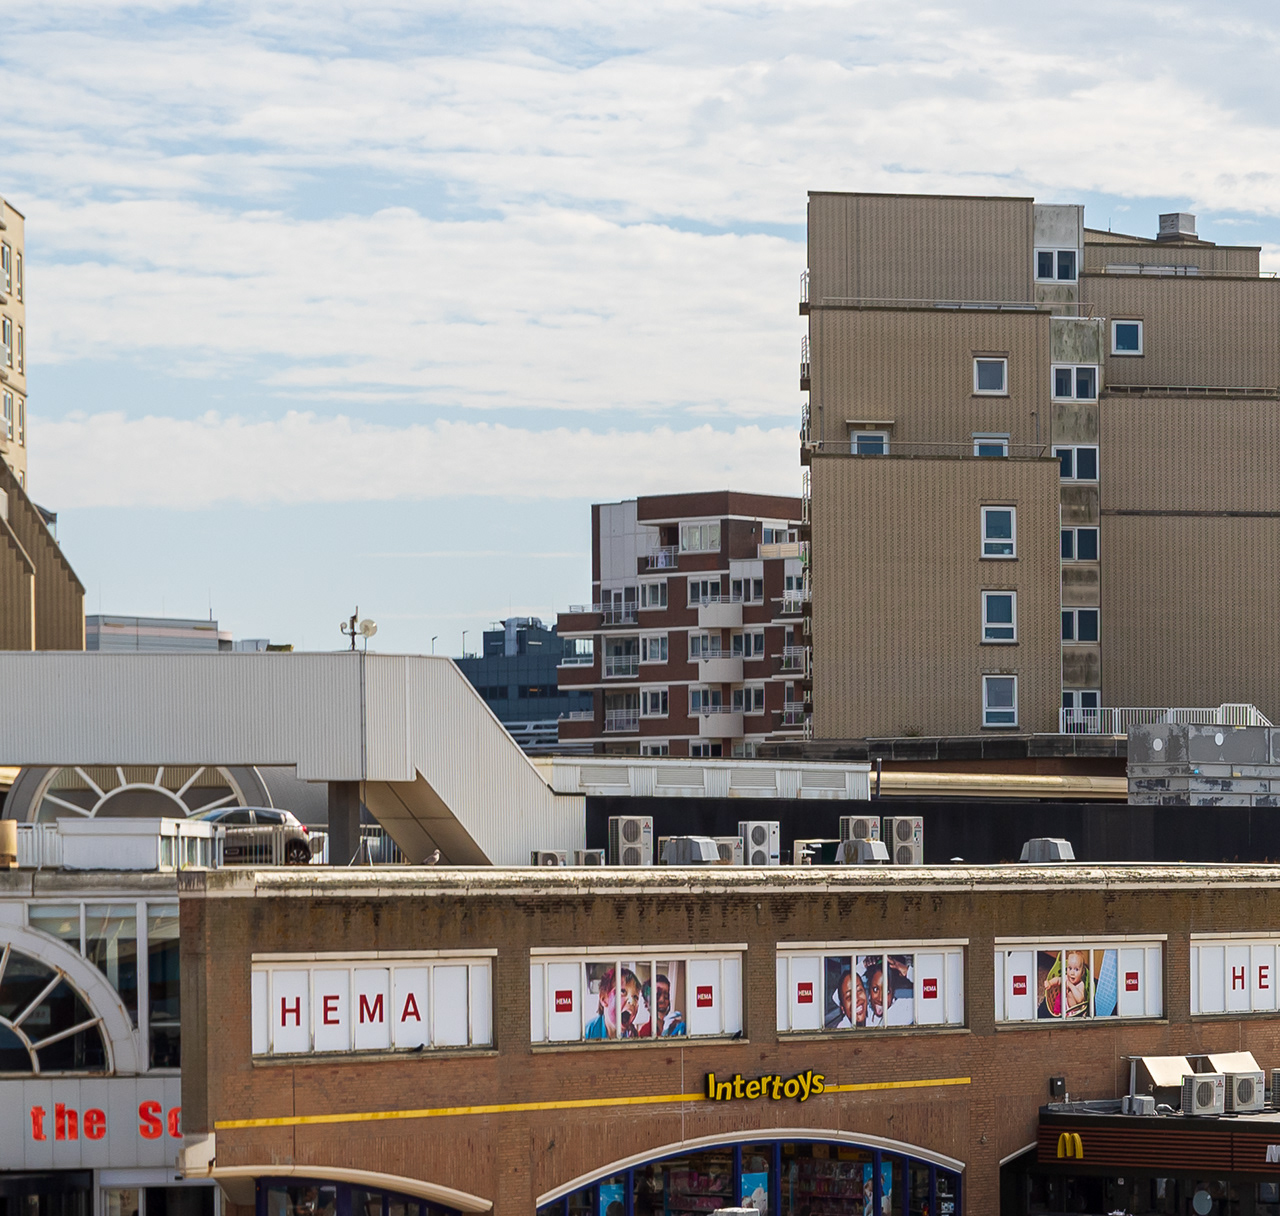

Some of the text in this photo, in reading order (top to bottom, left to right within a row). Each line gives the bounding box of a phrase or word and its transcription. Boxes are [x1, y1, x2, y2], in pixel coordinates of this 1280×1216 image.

[281, 992, 422, 1027] HEMA
[706, 1069, 825, 1102] Intertoys
[30, 1102, 107, 1141] the
